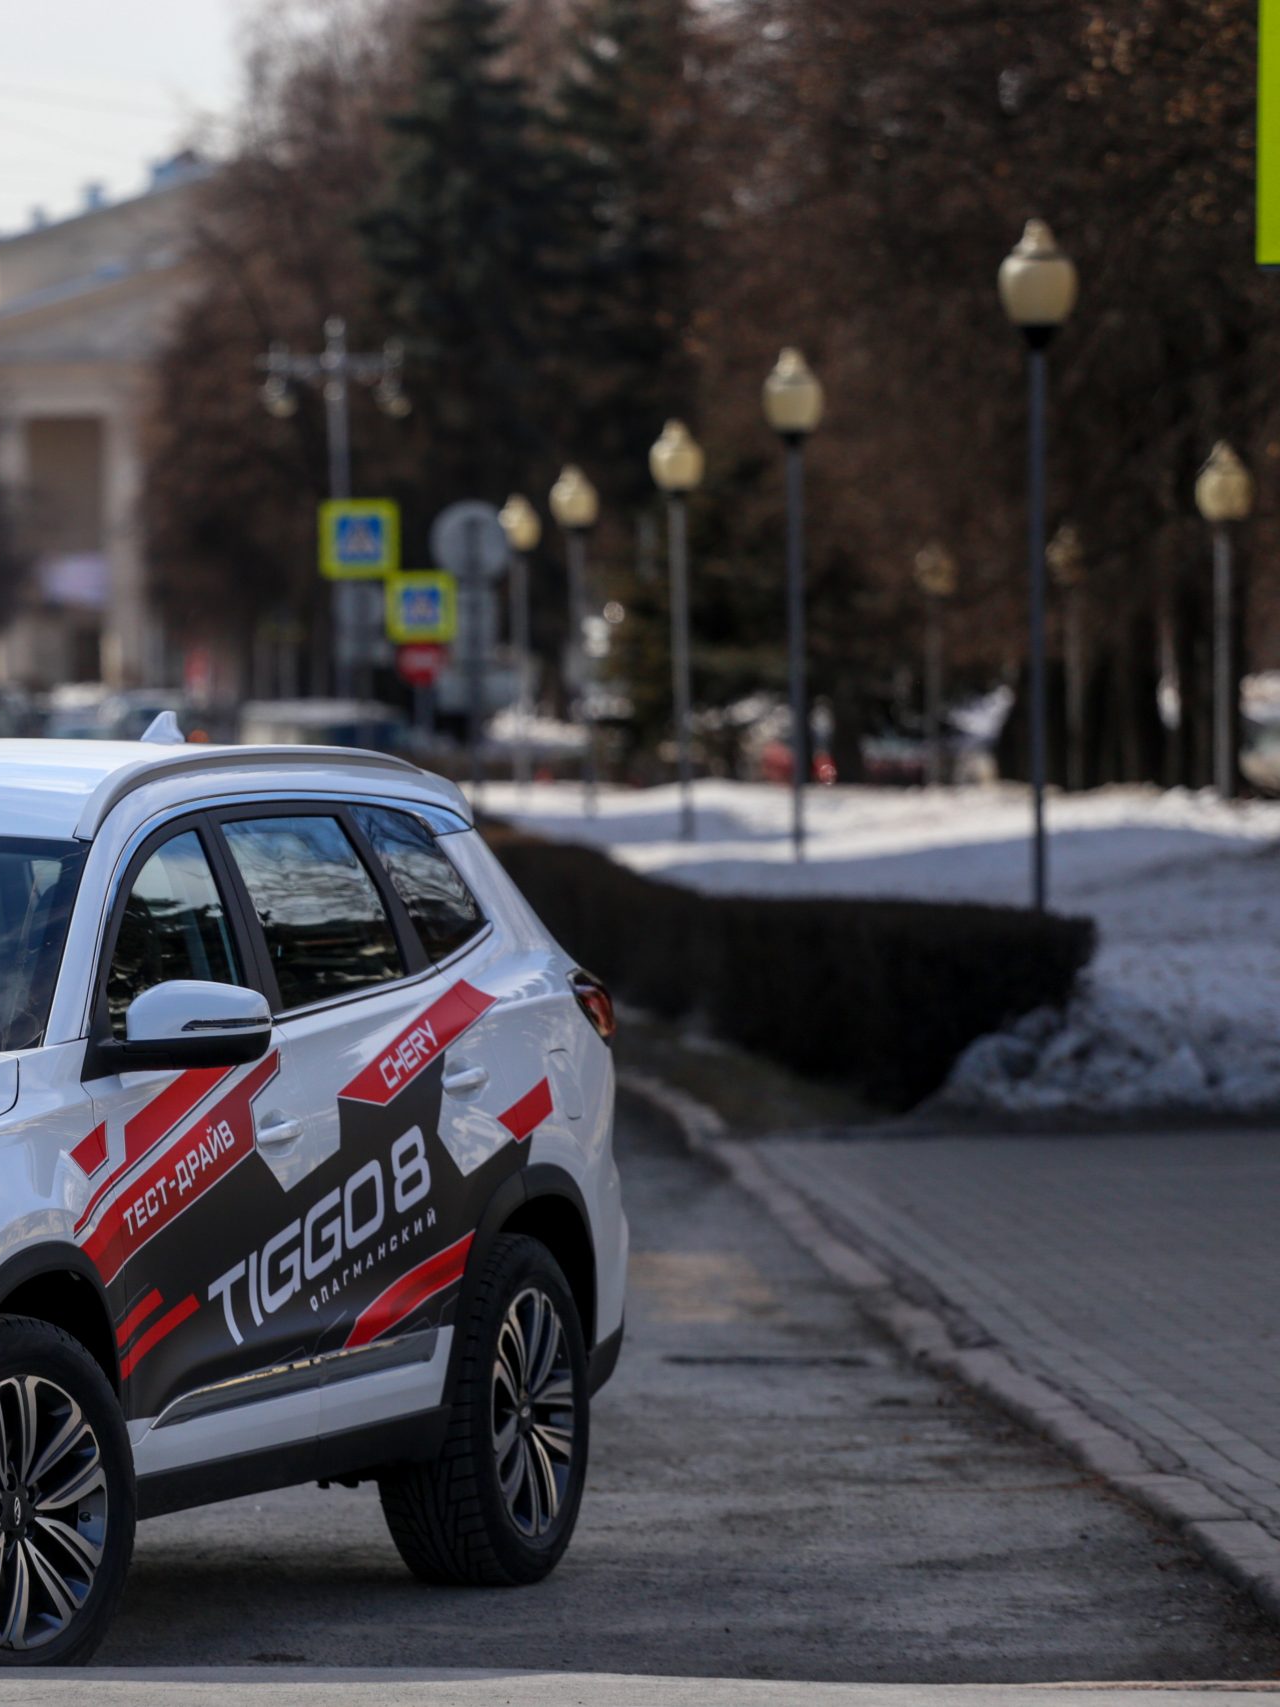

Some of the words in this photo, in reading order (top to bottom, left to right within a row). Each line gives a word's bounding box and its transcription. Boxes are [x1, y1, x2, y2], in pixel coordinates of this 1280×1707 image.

[379, 1020, 439, 1090] CHERY
[122, 1119, 236, 1237] ТЕСТ-ДРАЙВ
[208, 1159, 385, 1346] TIGGO
[391, 1124, 431, 1214] 8
